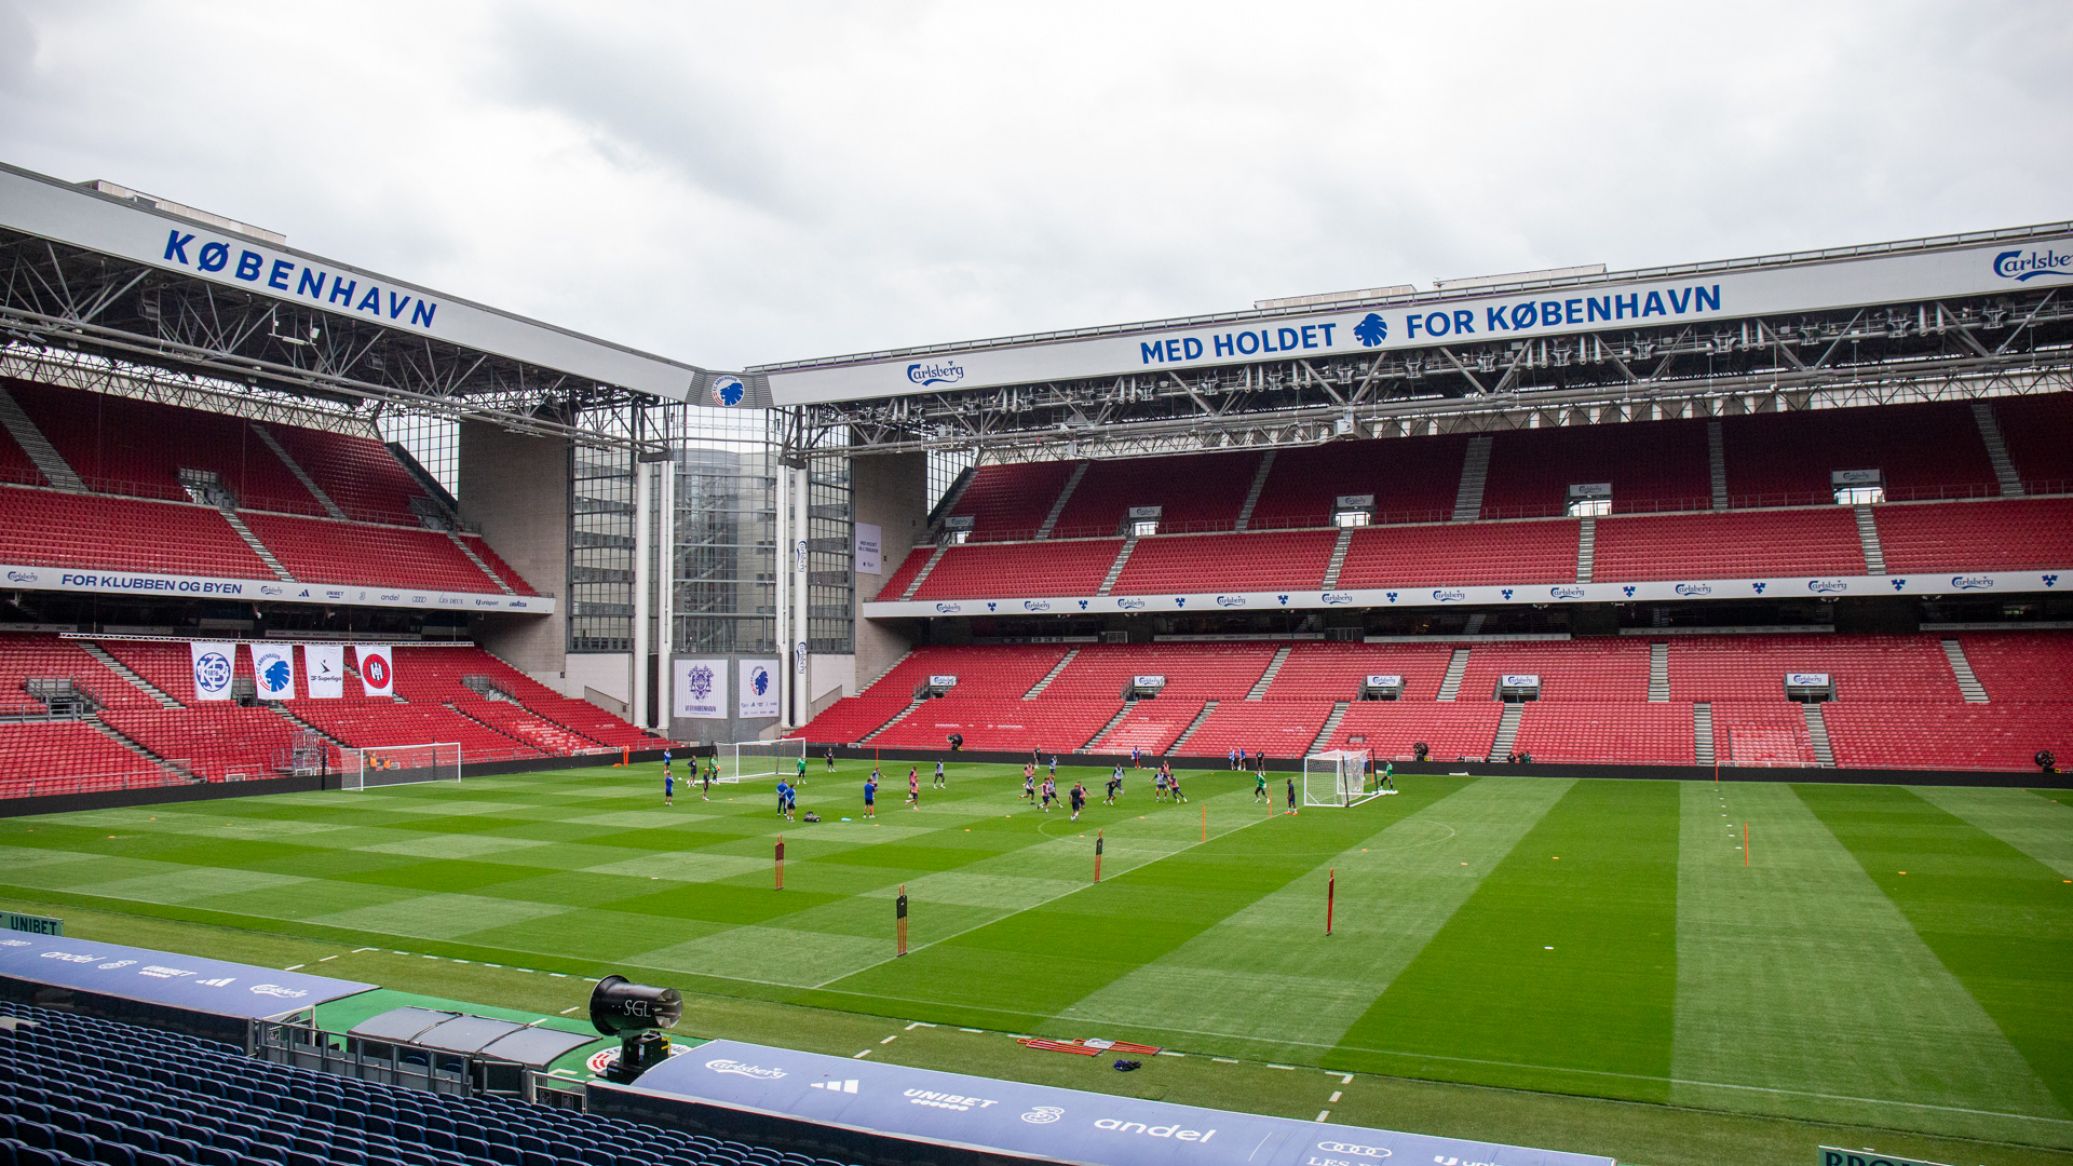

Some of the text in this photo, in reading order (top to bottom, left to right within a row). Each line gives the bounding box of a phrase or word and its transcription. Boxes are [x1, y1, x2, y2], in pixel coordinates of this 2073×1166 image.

[1993, 249, 2073, 282] Carlsbe
[163, 229, 437, 329] KØBENHAVN
[1140, 284, 1721, 365] MED HOLDET FOR KØBENHAVN
[906, 360, 964, 386] Carlsberg
[61, 573, 97, 587] FOR
[101, 576, 176, 591] KLUBBEN
[178, 581, 200, 593] OG
[203, 582, 242, 595] BYEN
[1675, 583, 1712, 596] Carlsberg
[1808, 580, 1847, 593] Carlsberg
[1951, 576, 1994, 590] Carlsberg
[1217, 595, 1246, 607] Carlsberg
[1322, 592, 1353, 605] Carlsberg
[1433, 590, 1465, 602] Carlsberg
[1550, 587, 1585, 599] Carlsberg
[1117, 598, 1145, 609] Carlsberg
[1793, 674, 1822, 684] Carlsberg
[11, 916, 57, 936] UNIBET
[623, 1000, 651, 1017] SGL
[705, 1059, 788, 1079] Carlsberg
[904, 1088, 998, 1107] UNIBET
[1094, 1118, 1216, 1143] andel
